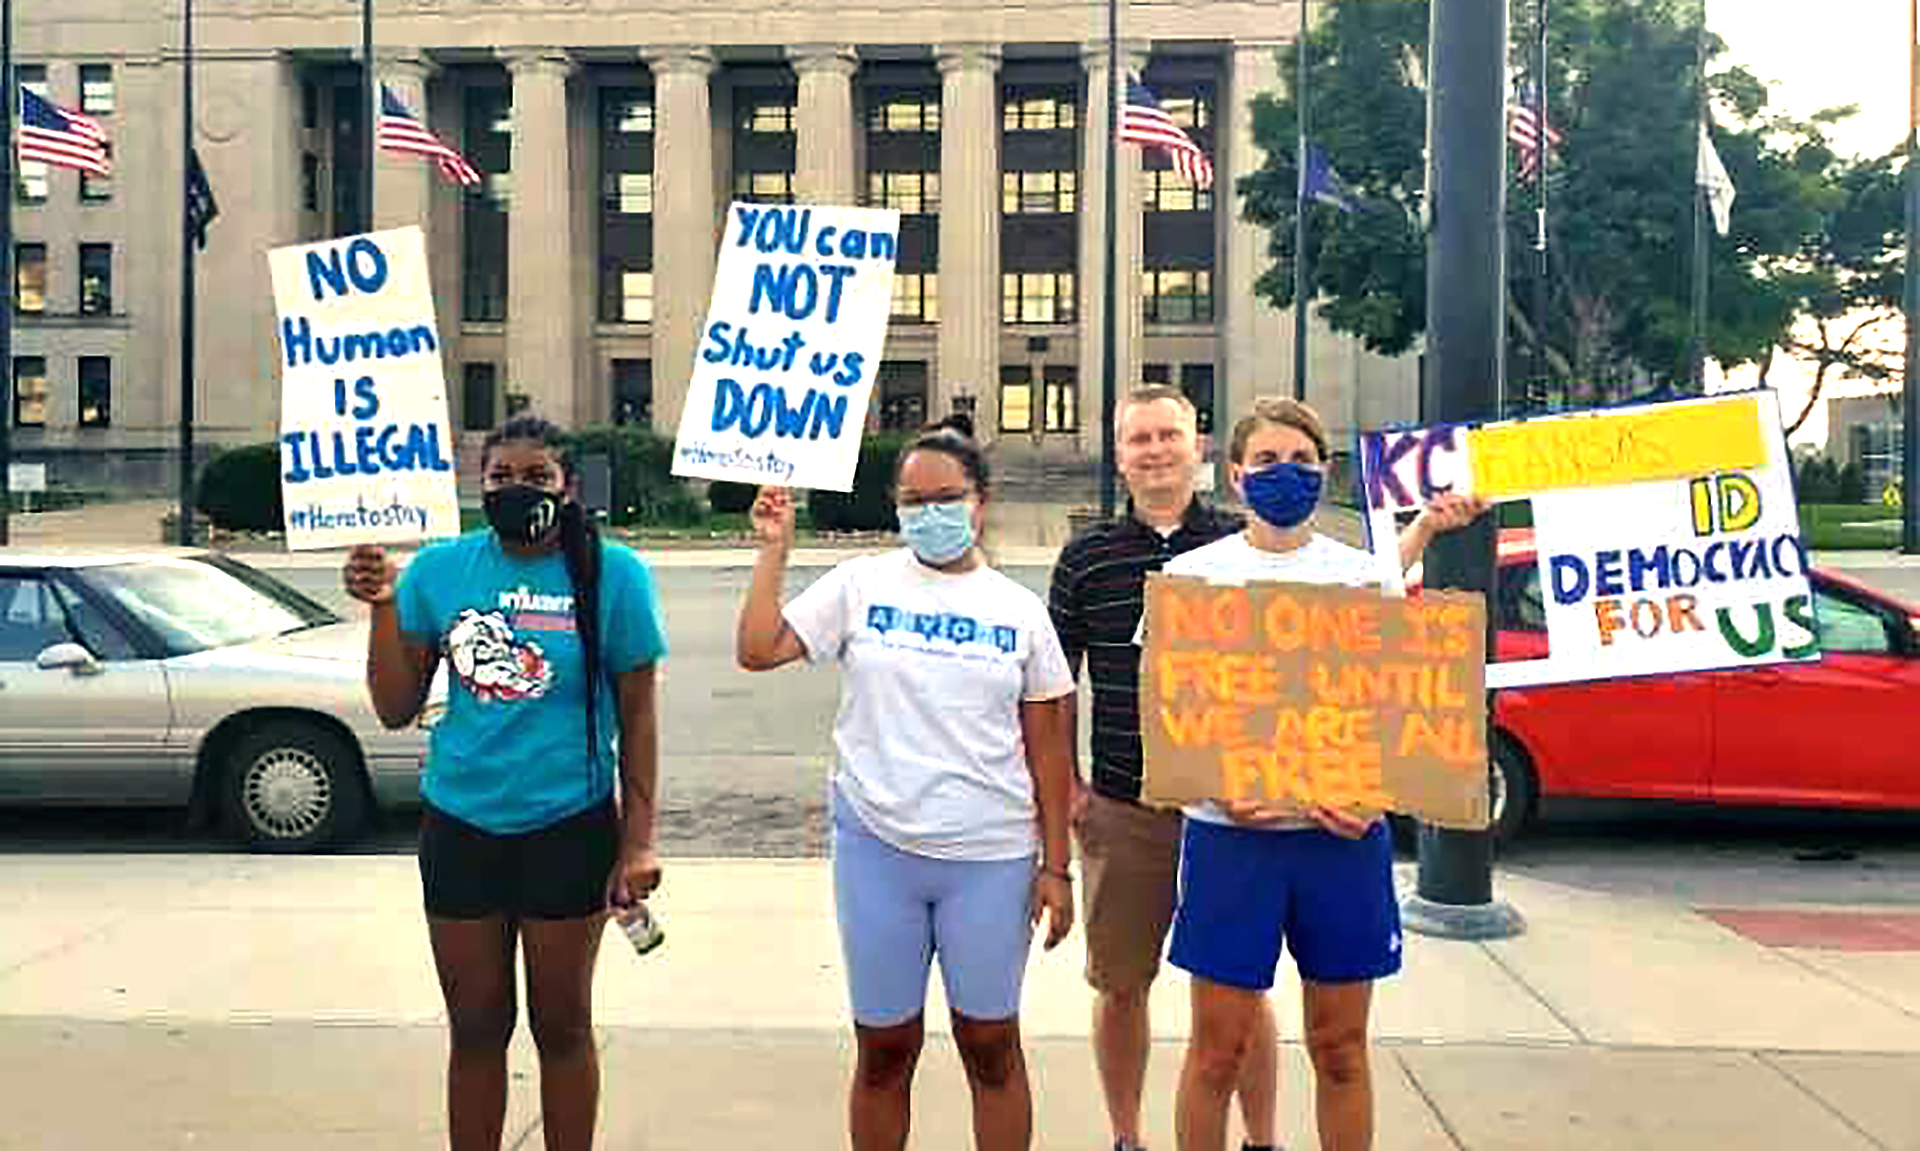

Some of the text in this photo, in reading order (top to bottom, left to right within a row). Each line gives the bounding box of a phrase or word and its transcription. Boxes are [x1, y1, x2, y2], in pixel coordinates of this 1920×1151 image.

[735, 207, 895, 260] YOU can
[306, 238, 388, 301] NO
[747, 263, 857, 324] NOT
[703, 321, 865, 387] Shut us
[334, 376, 380, 420] IS
[711, 378, 848, 440] DOWN
[283, 423, 450, 483] ILLEGAL
[1363, 423, 1457, 509] KC
[1690, 473, 1762, 537] ID
[1160, 588, 1467, 657] NO ONE IS
[1592, 593, 1821, 659] FOR US
[1159, 652, 1466, 706] FREE UNTIL
[1160, 706, 1250, 749] WE
[1275, 706, 1382, 753] ARE
[1221, 751, 1384, 804] FREE
